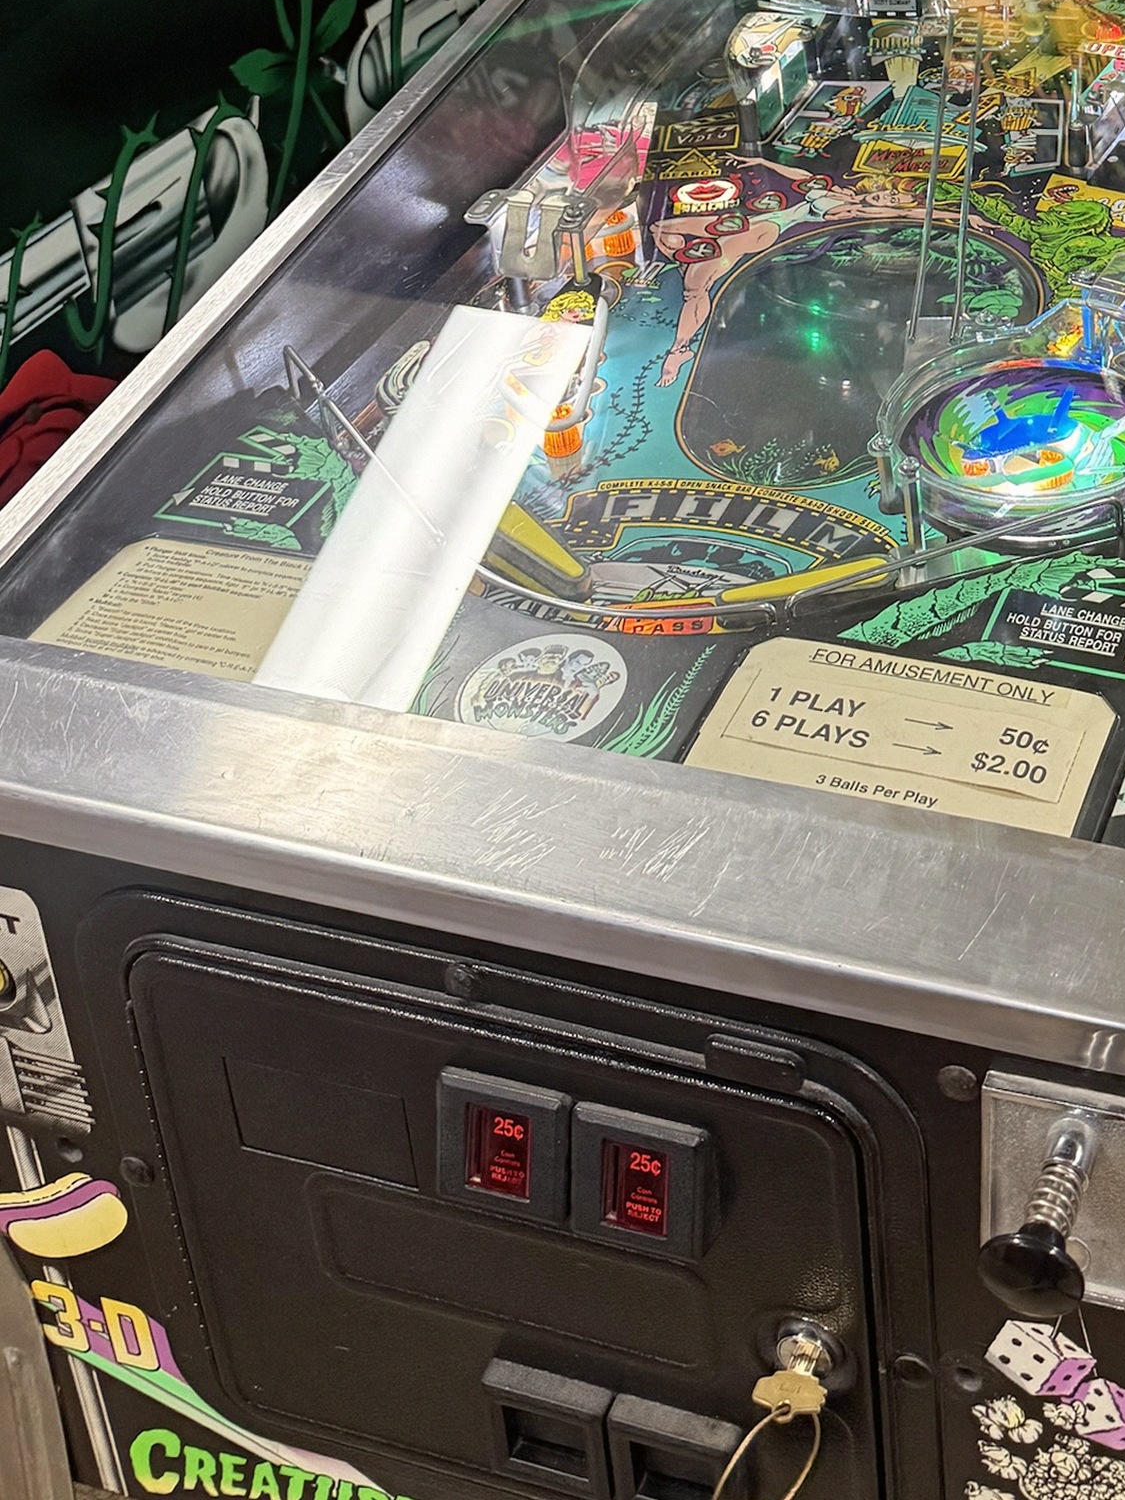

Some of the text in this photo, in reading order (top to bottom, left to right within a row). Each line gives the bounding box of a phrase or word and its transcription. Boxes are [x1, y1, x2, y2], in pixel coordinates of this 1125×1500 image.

[866, 119, 928, 132] Snack
[214, 473, 289, 492] LANE CHANGE
[193, 495, 277, 514] STATUS REPORT
[201, 486, 300, 508] HOLD BUTTON FOR
[600, 480, 645, 491] COMPLETE
[679, 480, 702, 489] OPEN
[705, 482, 733, 492] SNACK
[735, 485, 751, 494] BAR
[756, 488, 798, 503] COMPLETE
[825, 505, 859, 524] SHOOT
[858, 518, 889, 536] SLIDE
[1041, 603, 1076, 617] LANE
[1006, 612, 1123, 643] HOLD BUTTON FOR
[1021, 628, 1119, 654] STATUS REPORT
[811, 648, 1056, 704] FOR AMUSEMENT ONLY
[484, 678, 590, 721] UNIVERSAL
[473, 702, 578, 735] MONSTERS
[769, 686, 1051, 755] 1 PLAY 50¢
[751, 709, 1048, 785] 6 PLAYS $2.00
[815, 773, 939, 809] 3 Balls Per Play
[493, 1116, 525, 1141] 25¢
[629, 1152, 662, 1177] 25¢
[626, 1201, 663, 1216] PUSH TO
[627, 1209, 660, 1223] REJECT
[31, 1279, 161, 1372] 3-D
[130, 1428, 420, 1500] CREATU
